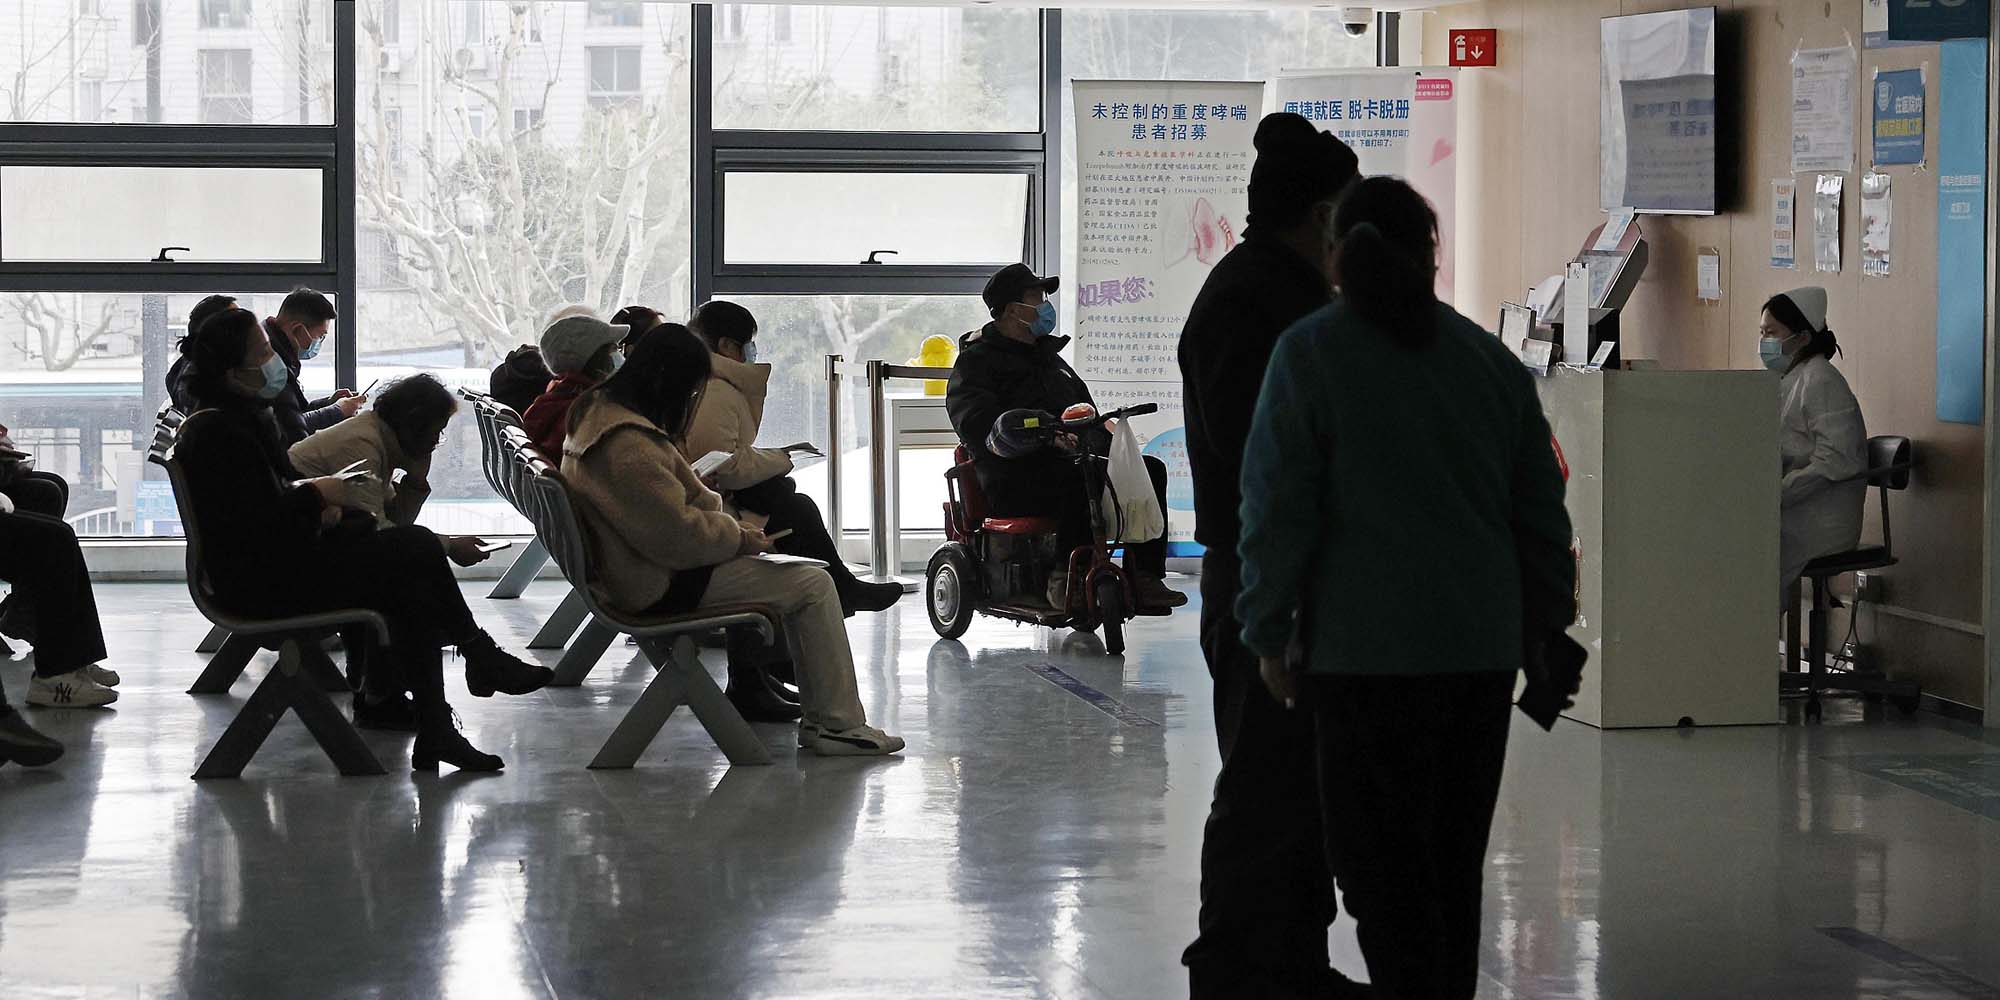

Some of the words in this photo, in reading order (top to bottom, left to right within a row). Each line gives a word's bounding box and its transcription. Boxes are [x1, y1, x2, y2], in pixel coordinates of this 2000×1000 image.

[1092, 103, 1247, 121] 未控制的重度哮喘
[1349, 100, 1409, 120] 脱卡脱册
[1132, 124, 1207, 140] 患者招募
